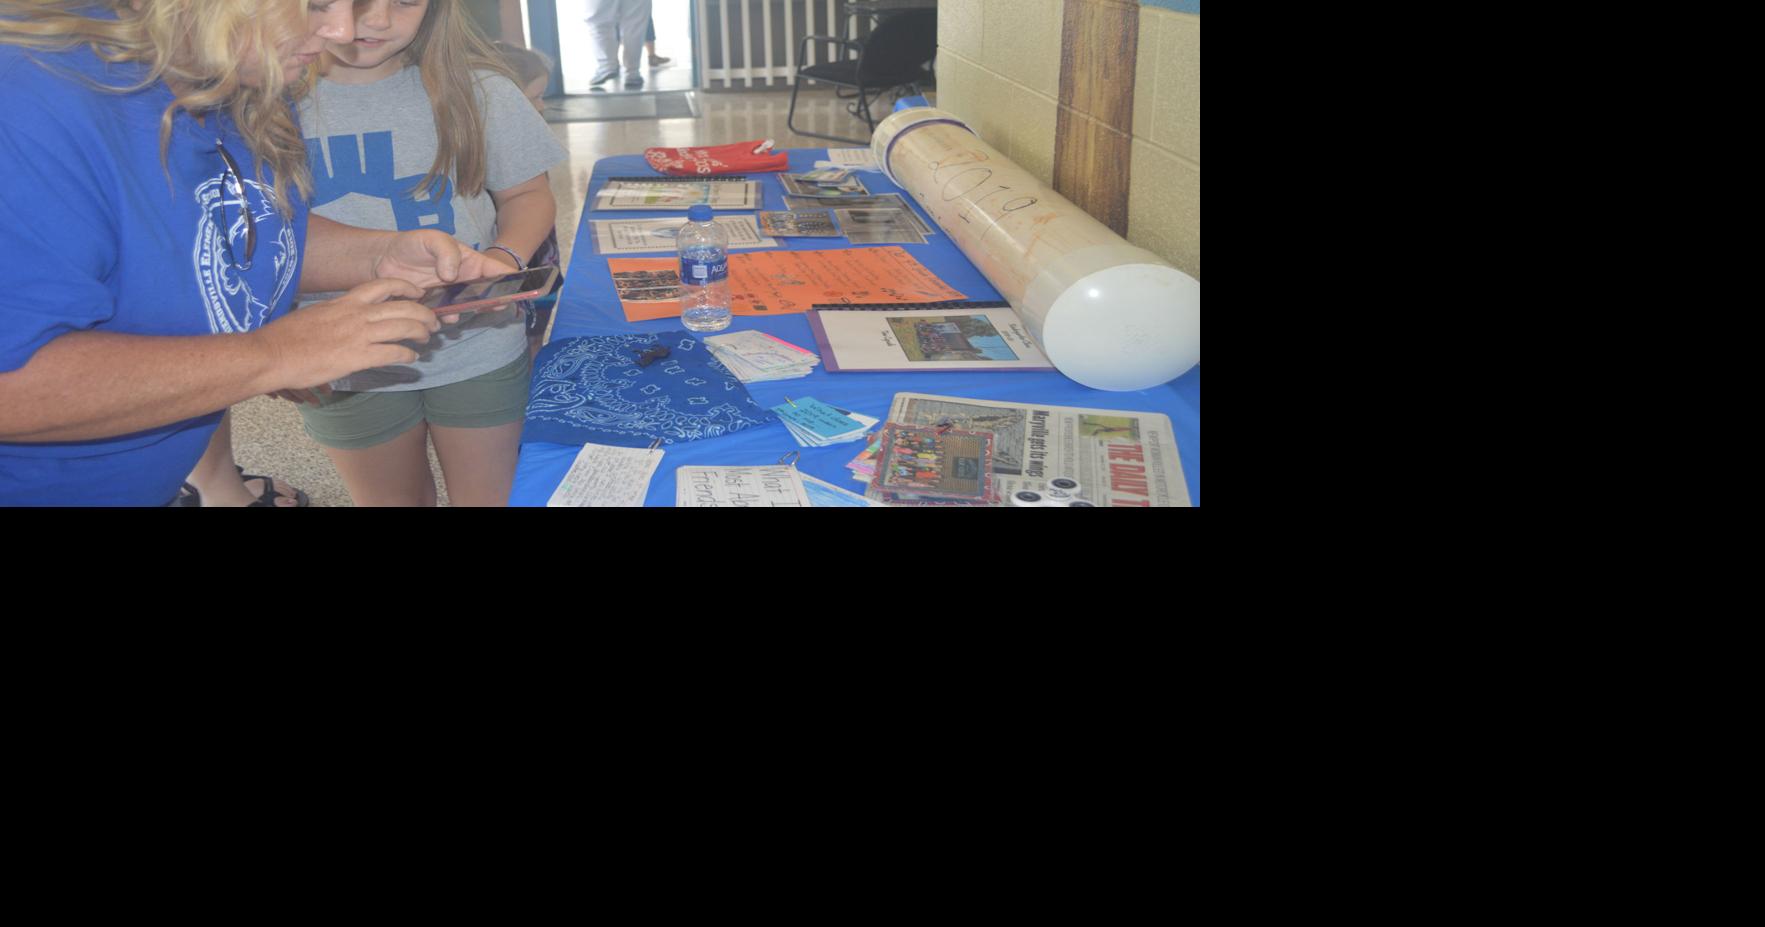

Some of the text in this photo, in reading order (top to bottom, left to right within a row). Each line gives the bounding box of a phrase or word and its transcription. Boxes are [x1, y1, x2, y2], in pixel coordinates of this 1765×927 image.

[928, 149, 1038, 241] 2019
[1028, 410, 1050, 437] Maryville
[1028, 437, 1049, 450] gets
[1107, 443, 1145, 462] THE
[1030, 451, 1049, 459] its
[760, 467, 792, 493] What
[1025, 460, 1049, 478] wings
[1110, 463, 1149, 497] DAILY
